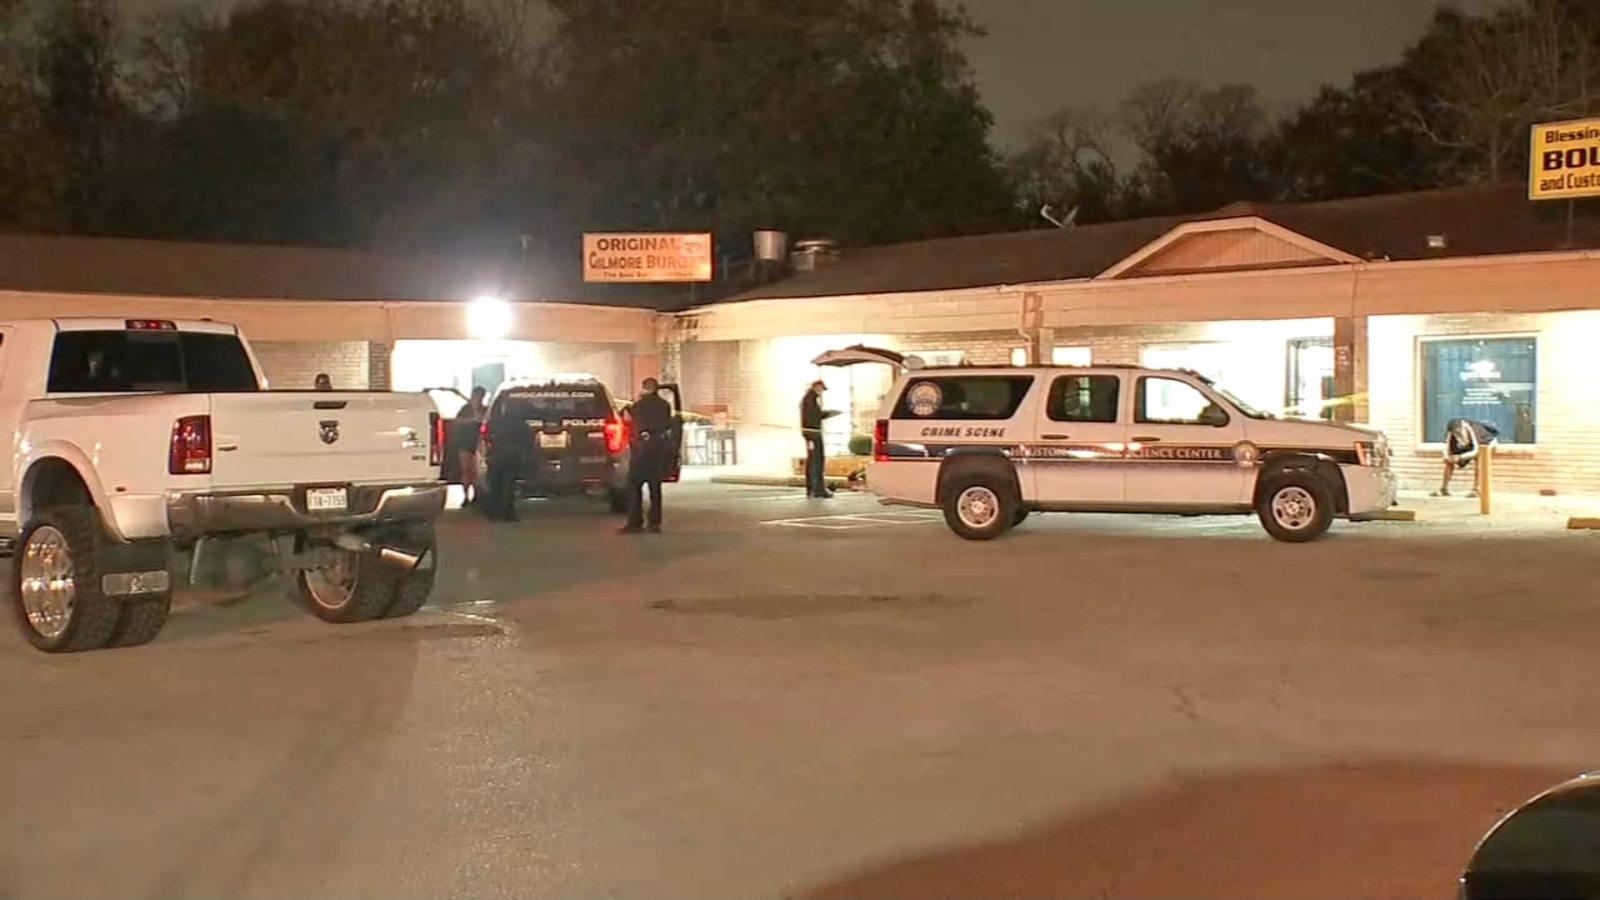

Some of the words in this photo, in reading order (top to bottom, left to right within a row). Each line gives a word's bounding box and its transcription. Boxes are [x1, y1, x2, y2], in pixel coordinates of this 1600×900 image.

[1545, 126, 1600, 143] Blessin
[1540, 174, 1564, 191] and
[597, 238, 680, 251] ORIGINAL
[920, 427, 961, 437] CRIME
[964, 427, 1006, 438] SCENE
[1176, 448, 1221, 459] CENTER
